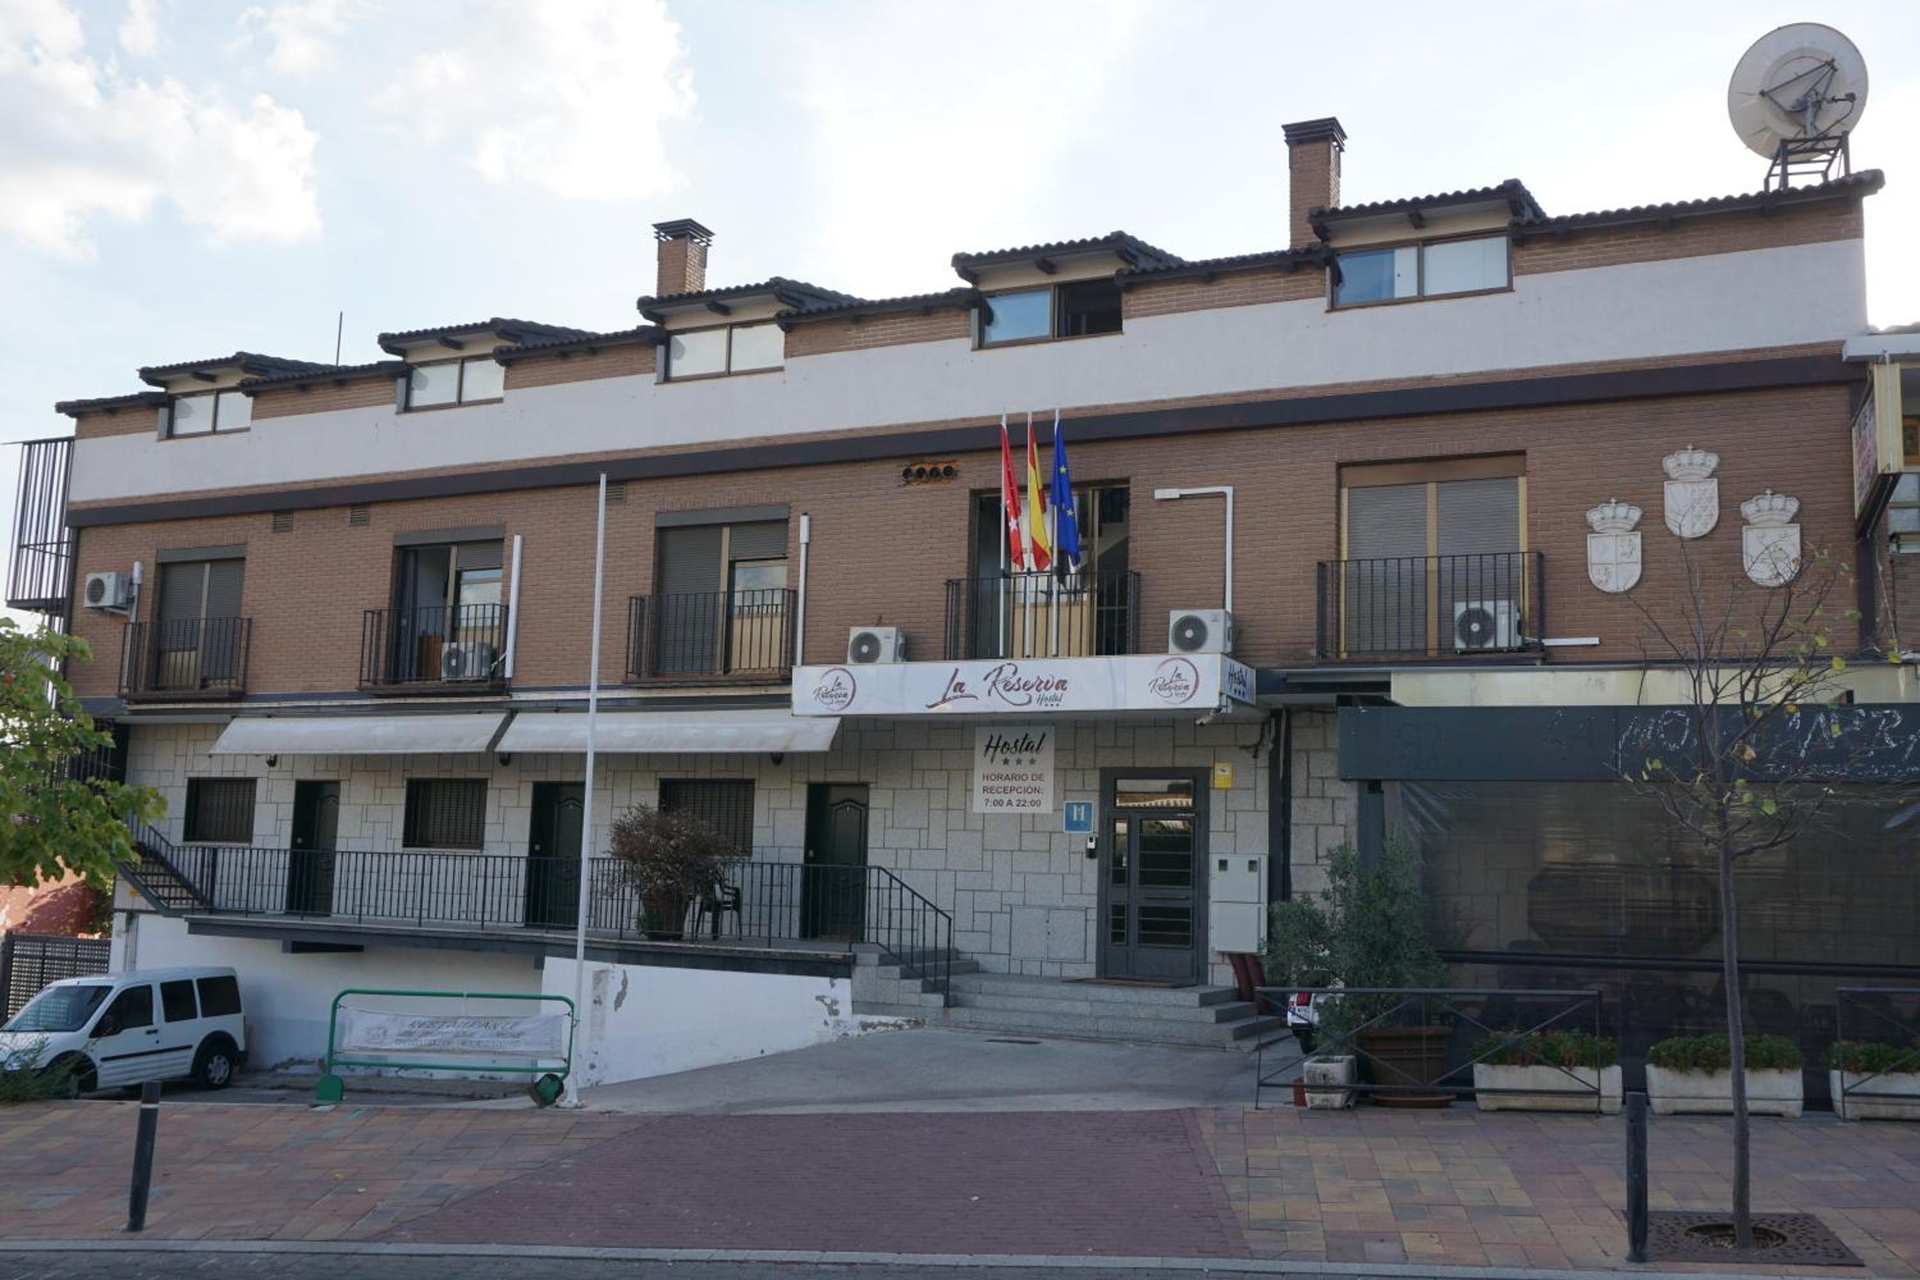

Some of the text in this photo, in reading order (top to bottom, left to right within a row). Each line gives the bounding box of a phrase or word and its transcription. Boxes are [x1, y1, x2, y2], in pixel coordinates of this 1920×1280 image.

[1164, 666, 1188, 686] La
[925, 662, 1068, 709] La Reserva
[983, 732, 1046, 764] Hostal
[983, 773, 1045, 782] HORARIO DE
[983, 784, 1044, 795] RECEPCIÓN:
[984, 798, 1042, 808] 7:00 A 22:00
